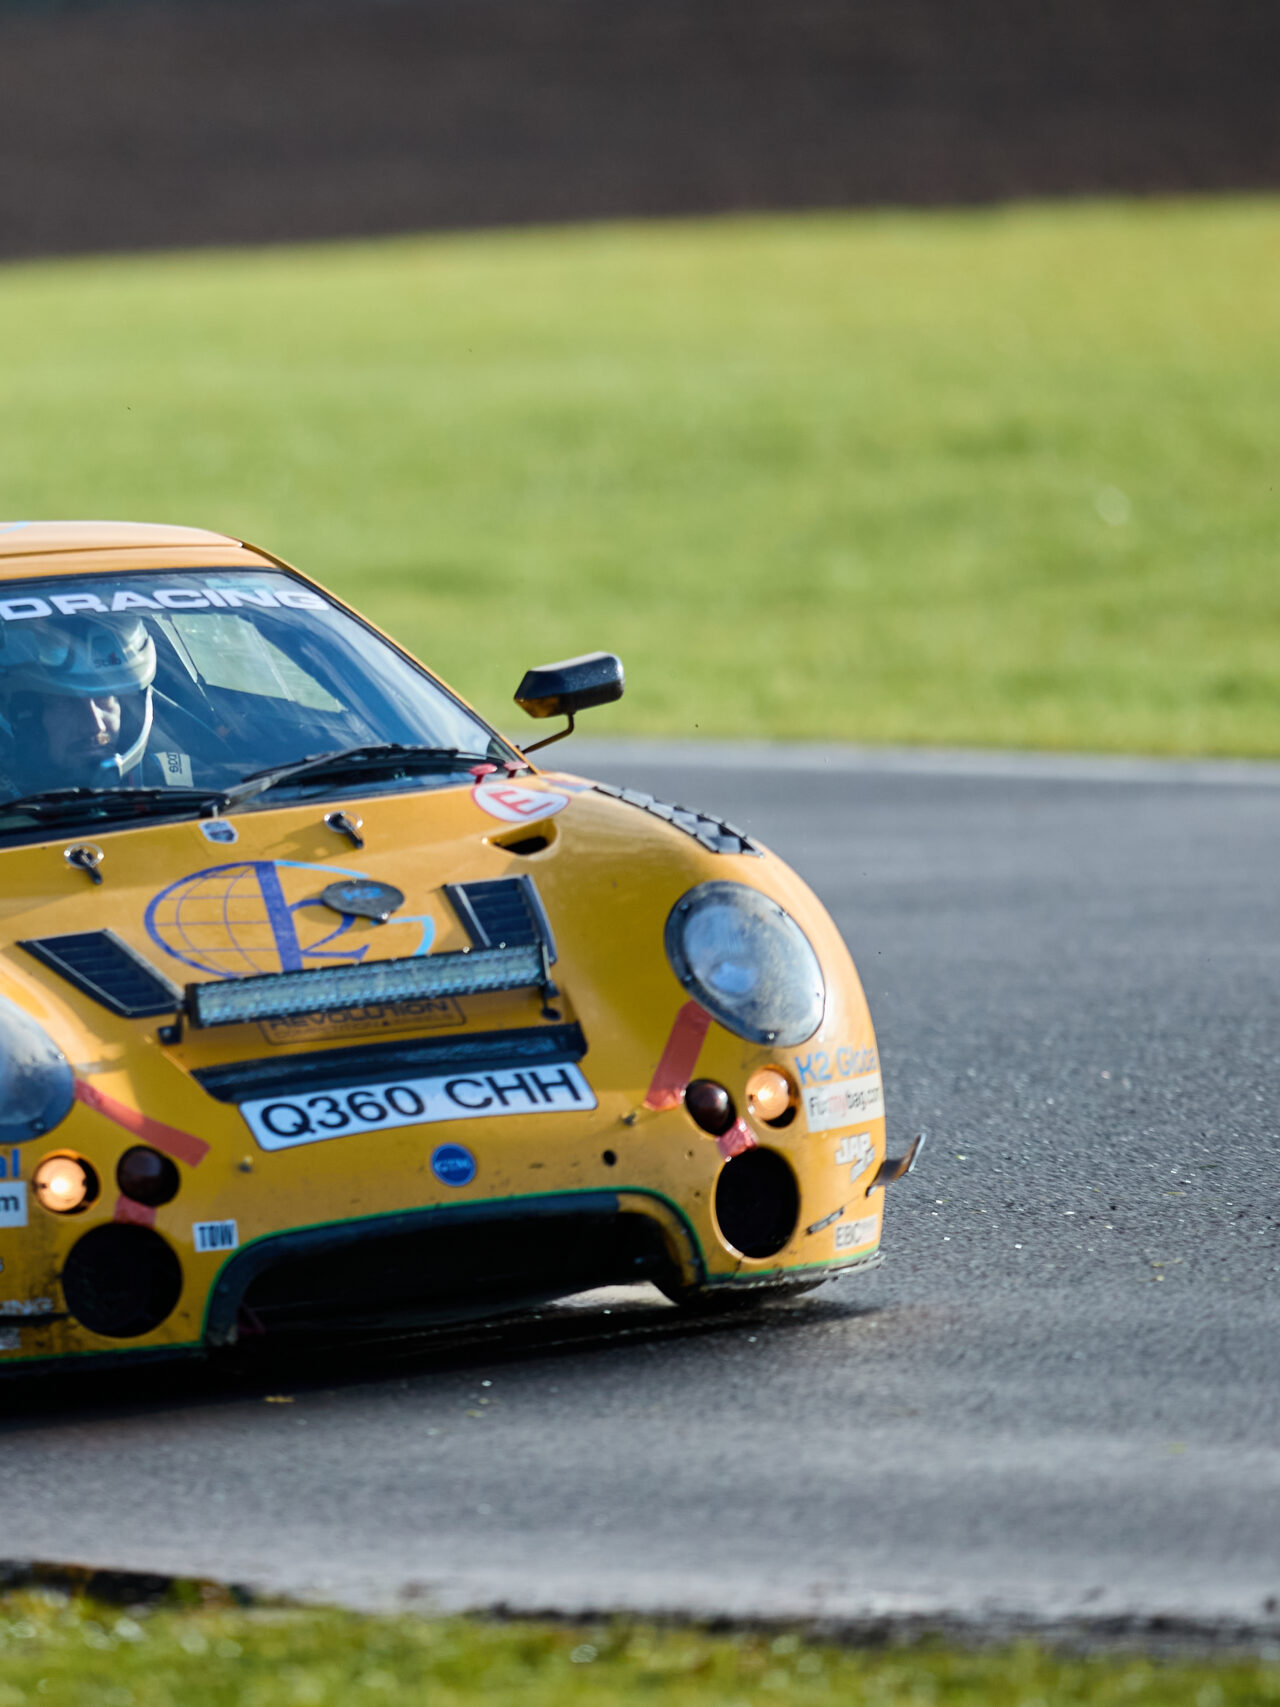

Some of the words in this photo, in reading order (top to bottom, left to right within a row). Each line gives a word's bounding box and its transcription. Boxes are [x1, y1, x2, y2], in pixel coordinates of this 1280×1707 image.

[794, 1050, 832, 1086] K2
[259, 1086, 423, 1138] Q360
[444, 1068, 583, 1110] CHH
[198, 1223, 236, 1249] TOW
